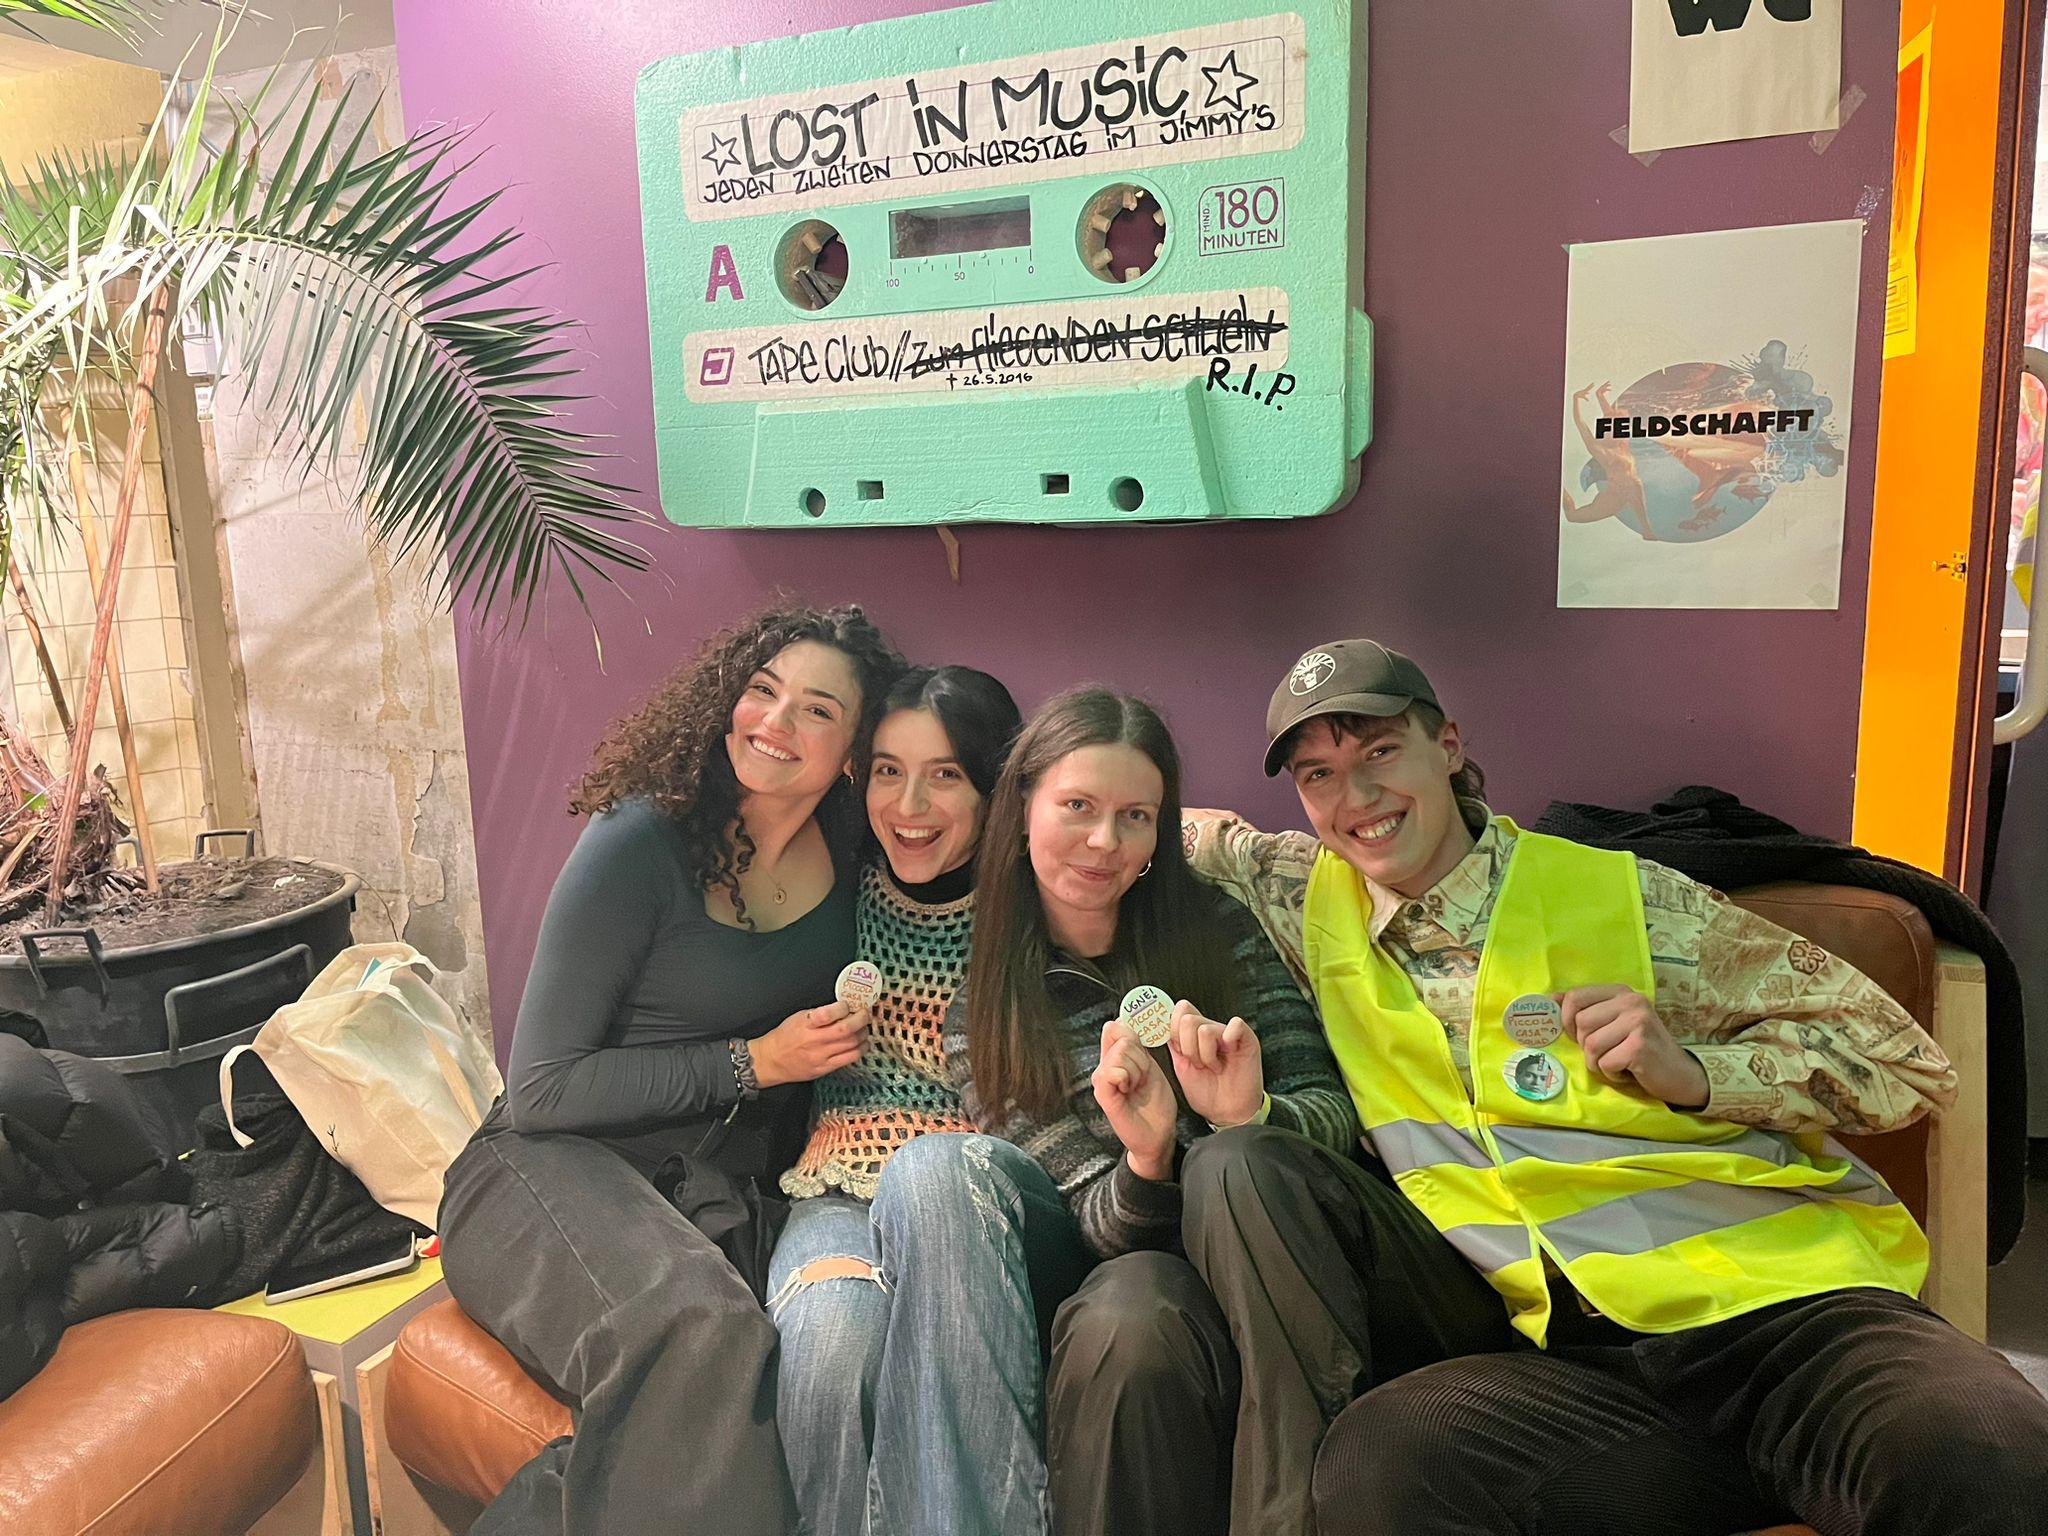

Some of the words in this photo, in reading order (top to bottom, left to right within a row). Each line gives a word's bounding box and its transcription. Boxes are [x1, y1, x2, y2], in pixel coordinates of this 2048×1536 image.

[741, 92, 879, 175] LOST
[992, 45, 1189, 131] MUSIC
[1160, 104, 1276, 145] JIMMY'S
[1214, 185, 1279, 230] 180
[1203, 228, 1278, 251] MINUTEN
[705, 244, 745, 303] A
[885, 278, 900, 288] 100
[954, 272, 966, 281] 50
[1028, 265, 1034, 274] 0
[1595, 409, 1815, 439] FELDSCHAFFT
[1127, 1001, 1165, 1031] PICCOLA
[1137, 1017, 1164, 1038] CASA
[1507, 1016, 1554, 1027] PICCOLA
[1515, 1029, 1542, 1037] CASA
